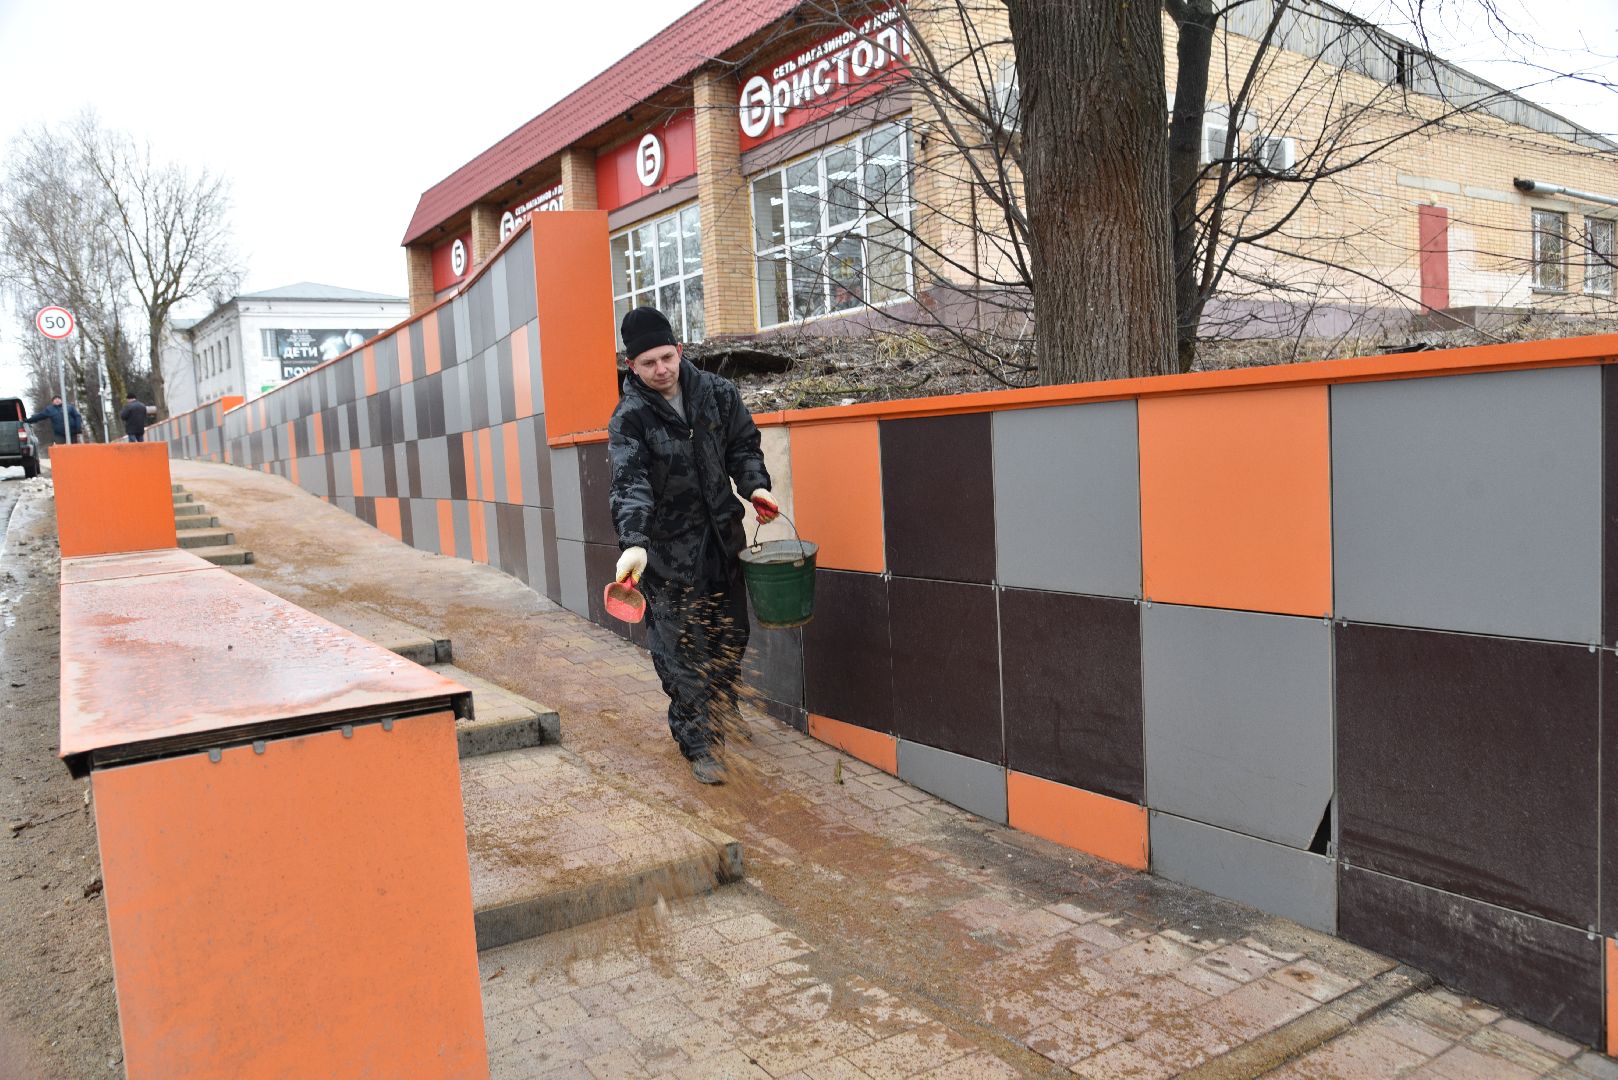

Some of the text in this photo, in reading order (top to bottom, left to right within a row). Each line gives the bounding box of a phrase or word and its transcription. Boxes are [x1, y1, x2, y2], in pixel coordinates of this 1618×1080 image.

[773, 60, 797, 79] СЕТЬ
[45, 316, 66, 329] 50
[283, 346, 318, 359] ДЕТИ
